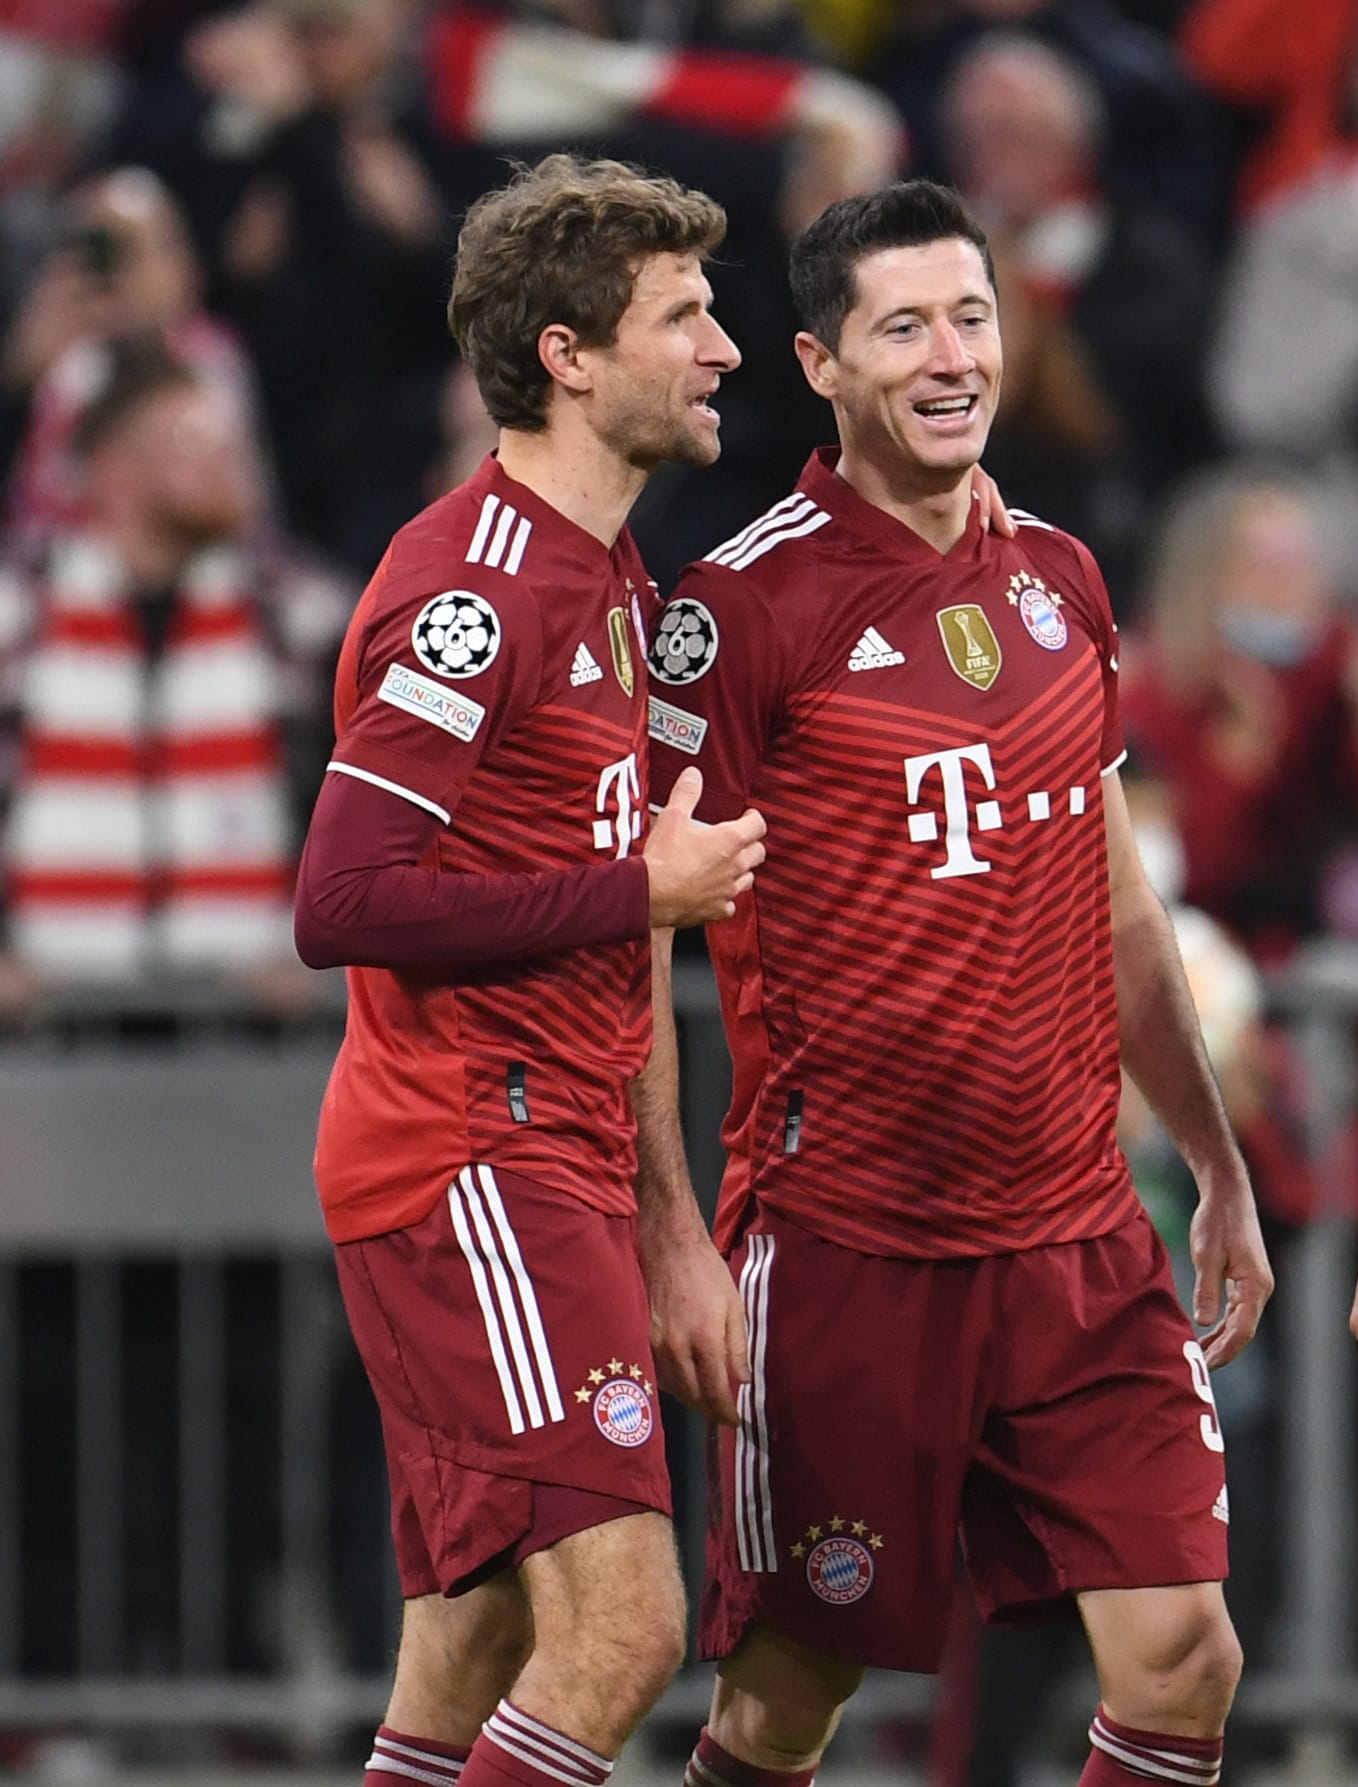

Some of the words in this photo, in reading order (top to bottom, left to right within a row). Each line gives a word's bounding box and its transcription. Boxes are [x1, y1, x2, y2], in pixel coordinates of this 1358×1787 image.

[443, 616, 468, 651] 6
[667, 625, 686, 657] 6
[848, 650, 906, 672] adidas
[598, 1395, 610, 1411] FC
[608, 1384, 646, 1408] BAYERN
[1183, 1340, 1225, 1453] 9
[811, 1552, 824, 1568] FC
[823, 1542, 867, 1565] BAYERN
